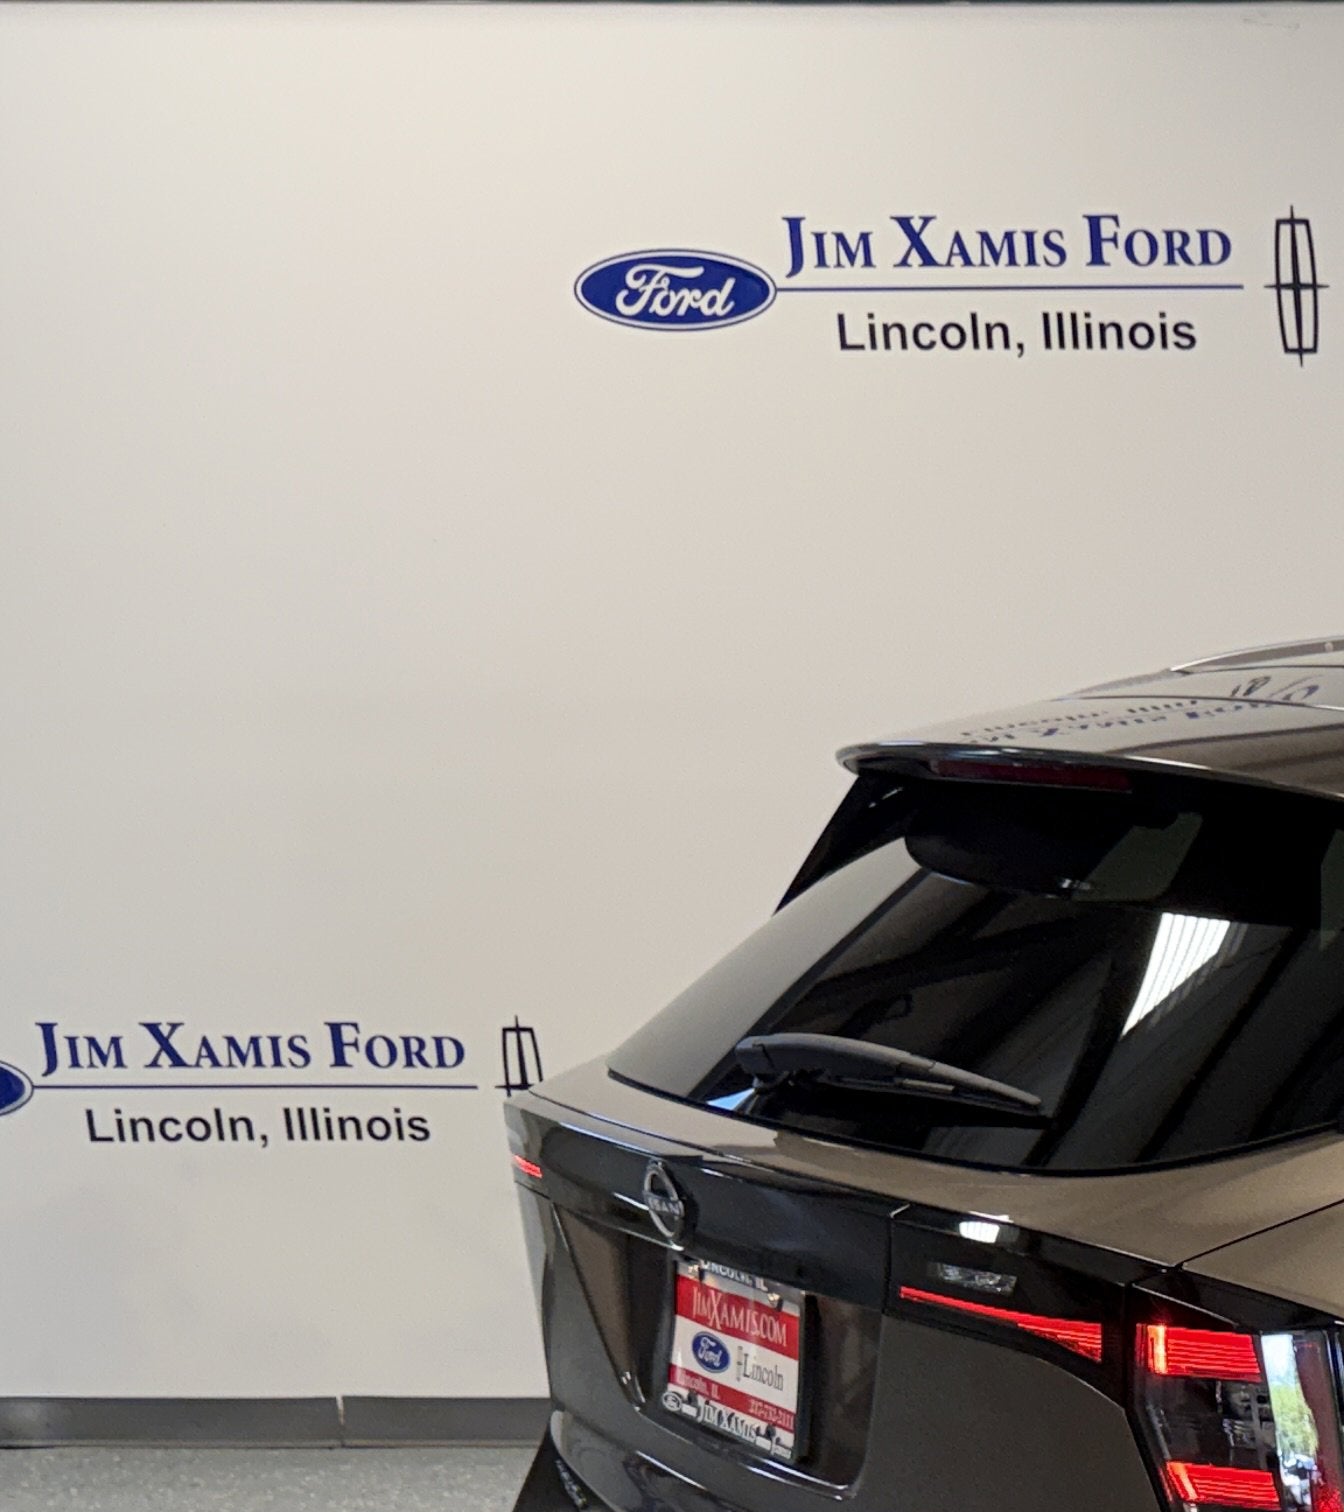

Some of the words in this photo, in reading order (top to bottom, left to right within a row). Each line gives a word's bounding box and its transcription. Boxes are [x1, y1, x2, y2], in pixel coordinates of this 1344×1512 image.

[615, 263, 734, 318] Ford
[836, 311, 1026, 358] Lincoln,
[1041, 310, 1198, 351] Illinois
[84, 1106, 269, 1149] Lincoln,
[282, 1106, 432, 1143] Illinois
